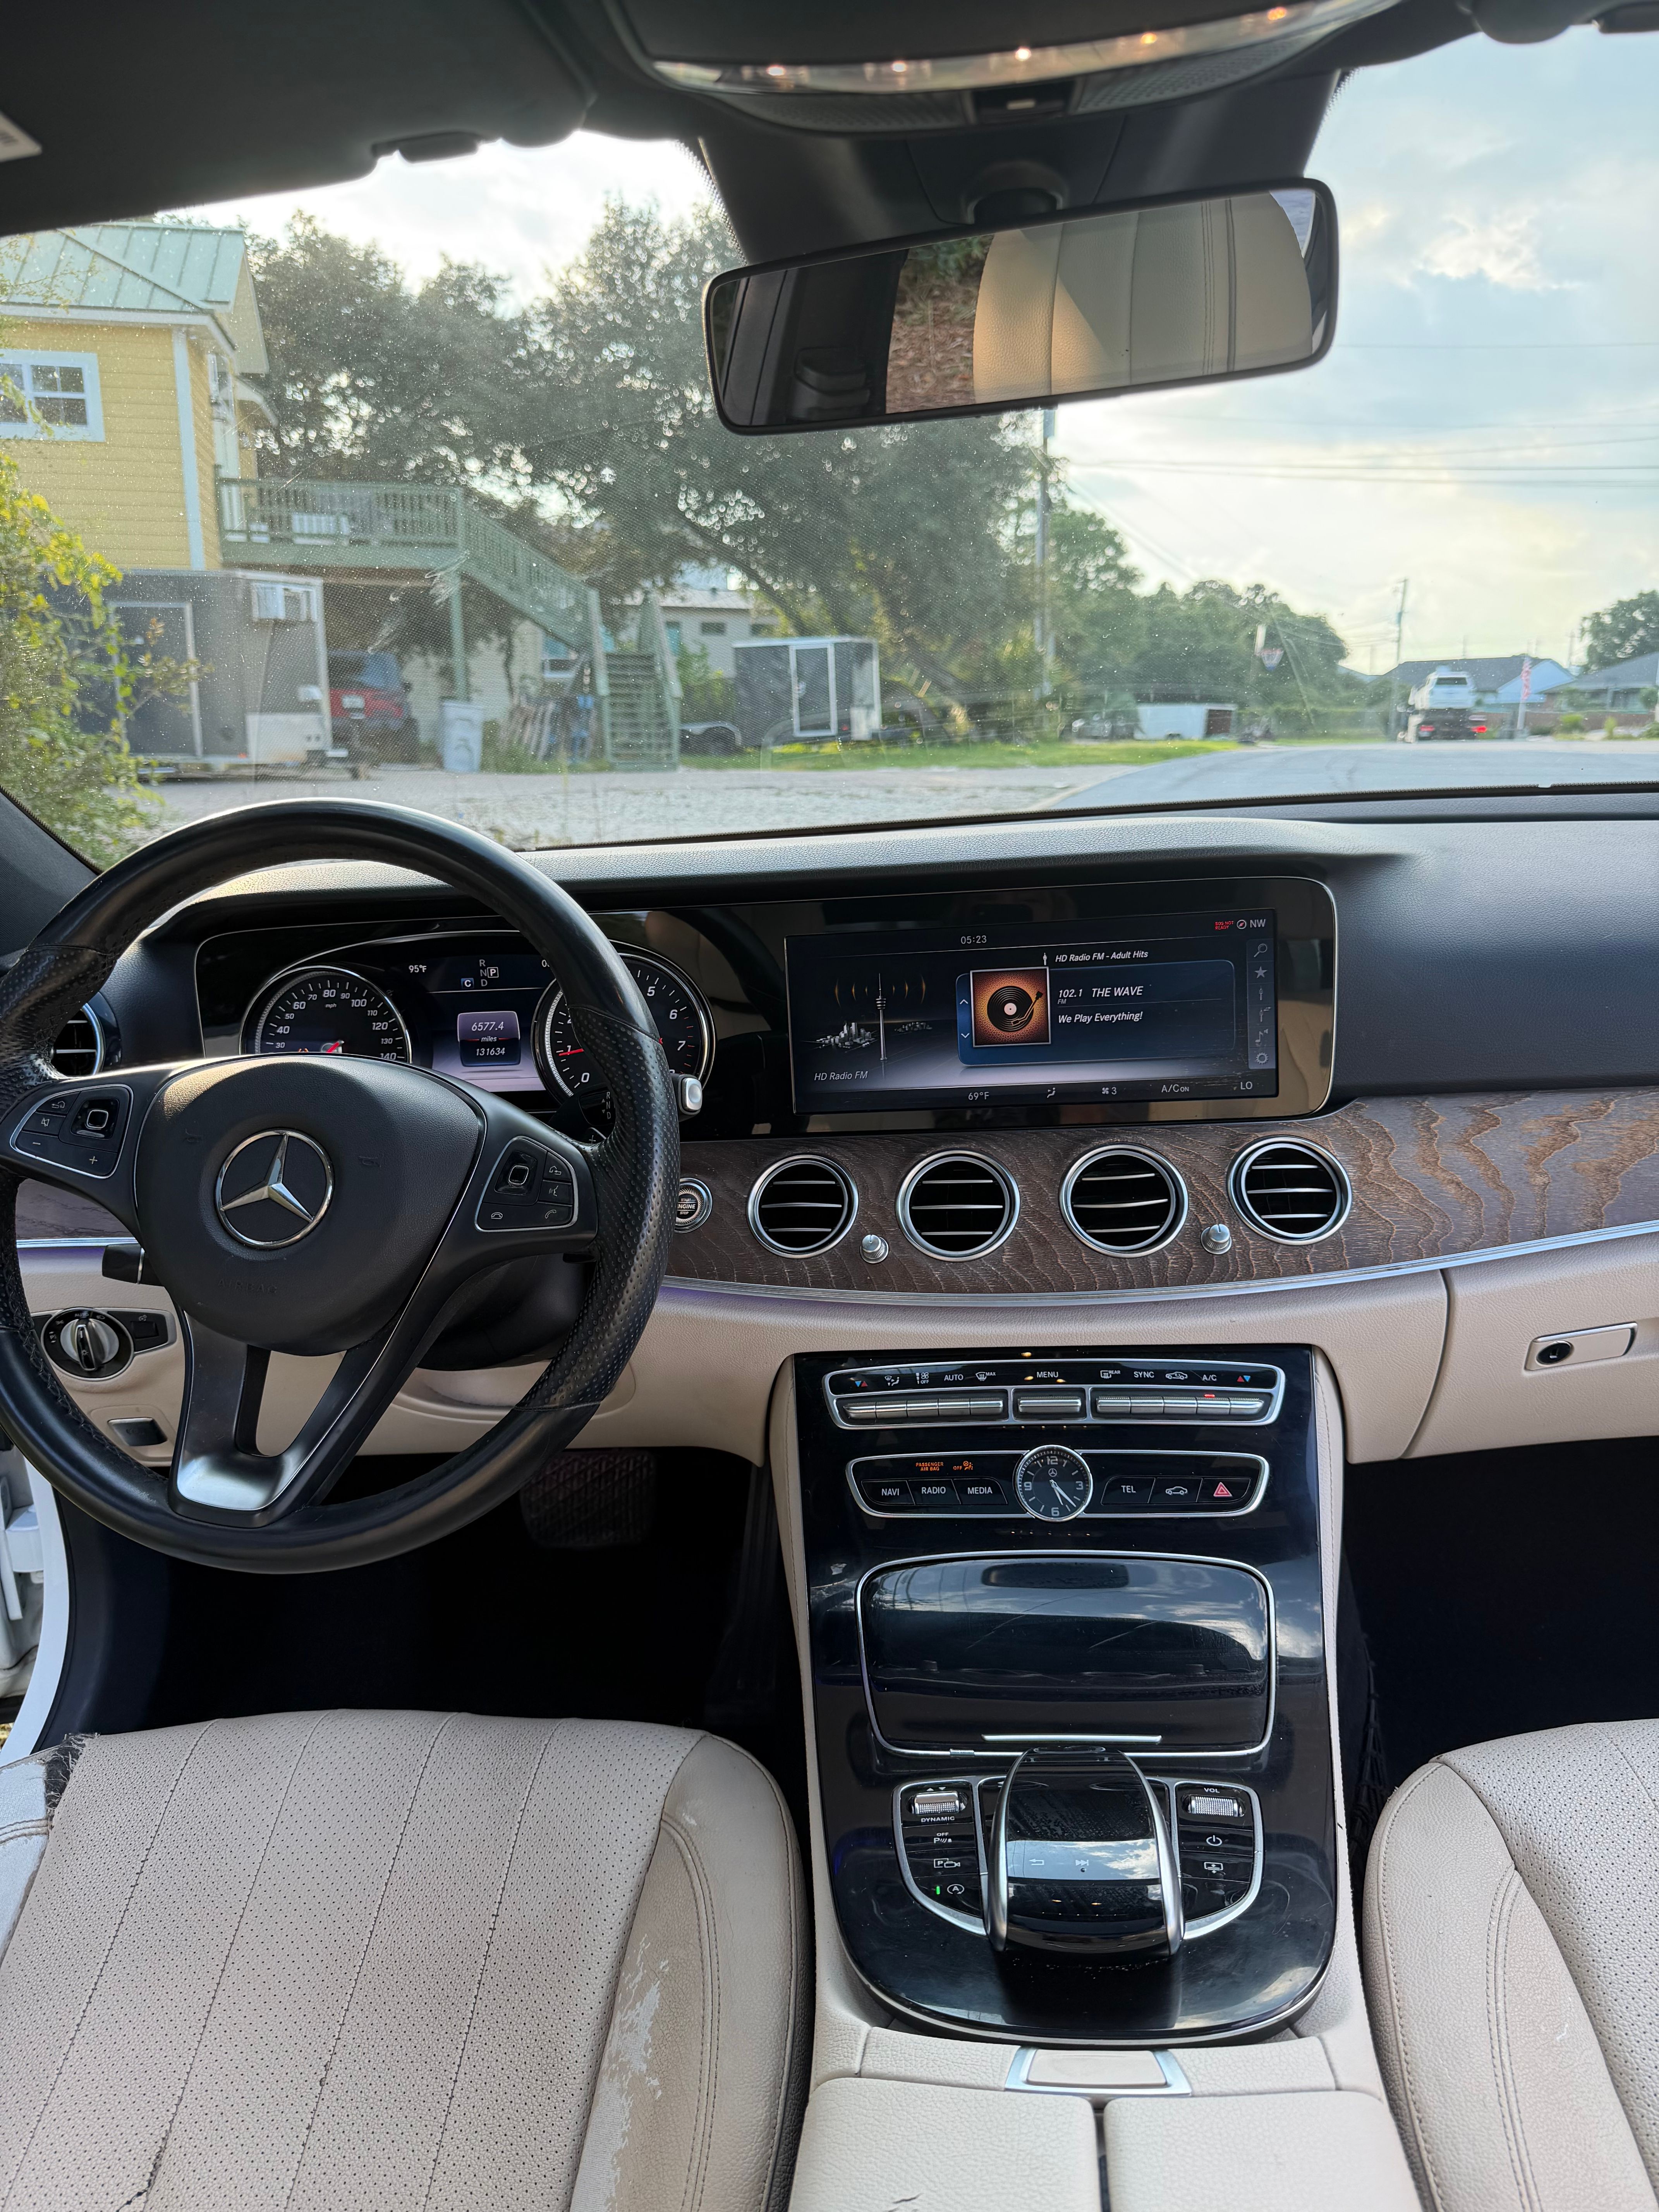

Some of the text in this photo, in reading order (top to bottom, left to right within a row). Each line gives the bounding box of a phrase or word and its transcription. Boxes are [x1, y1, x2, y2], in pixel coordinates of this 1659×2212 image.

[1250, 919, 1266, 928] NW
[960, 935, 987, 944] 05:23
[1110, 951, 1131, 959] Adult
[409, 965, 427, 973] 95°F
[647, 986, 655, 996] 5
[1059, 986, 1144, 998] 102.1 THE WAVE
[293, 1001, 306, 1010] 60
[670, 1010, 678, 1019] 6
[1058, 1011, 1143, 1024] We Play Everything!
[471, 1022, 504, 1031] 6577.4
[677, 1041, 686, 1051] 7
[476, 1048, 505, 1056] 131634
[581, 1073, 589, 1082] 0
[1240, 1081, 1253, 1090] LO
[968, 1092, 989, 1100] 69°F
[1046, 1456, 1058, 1465] 12
[1024, 1482, 1032, 1490] 9
[1075, 1481, 1083, 1490] 3
[1051, 1507, 1060, 1516] 6
